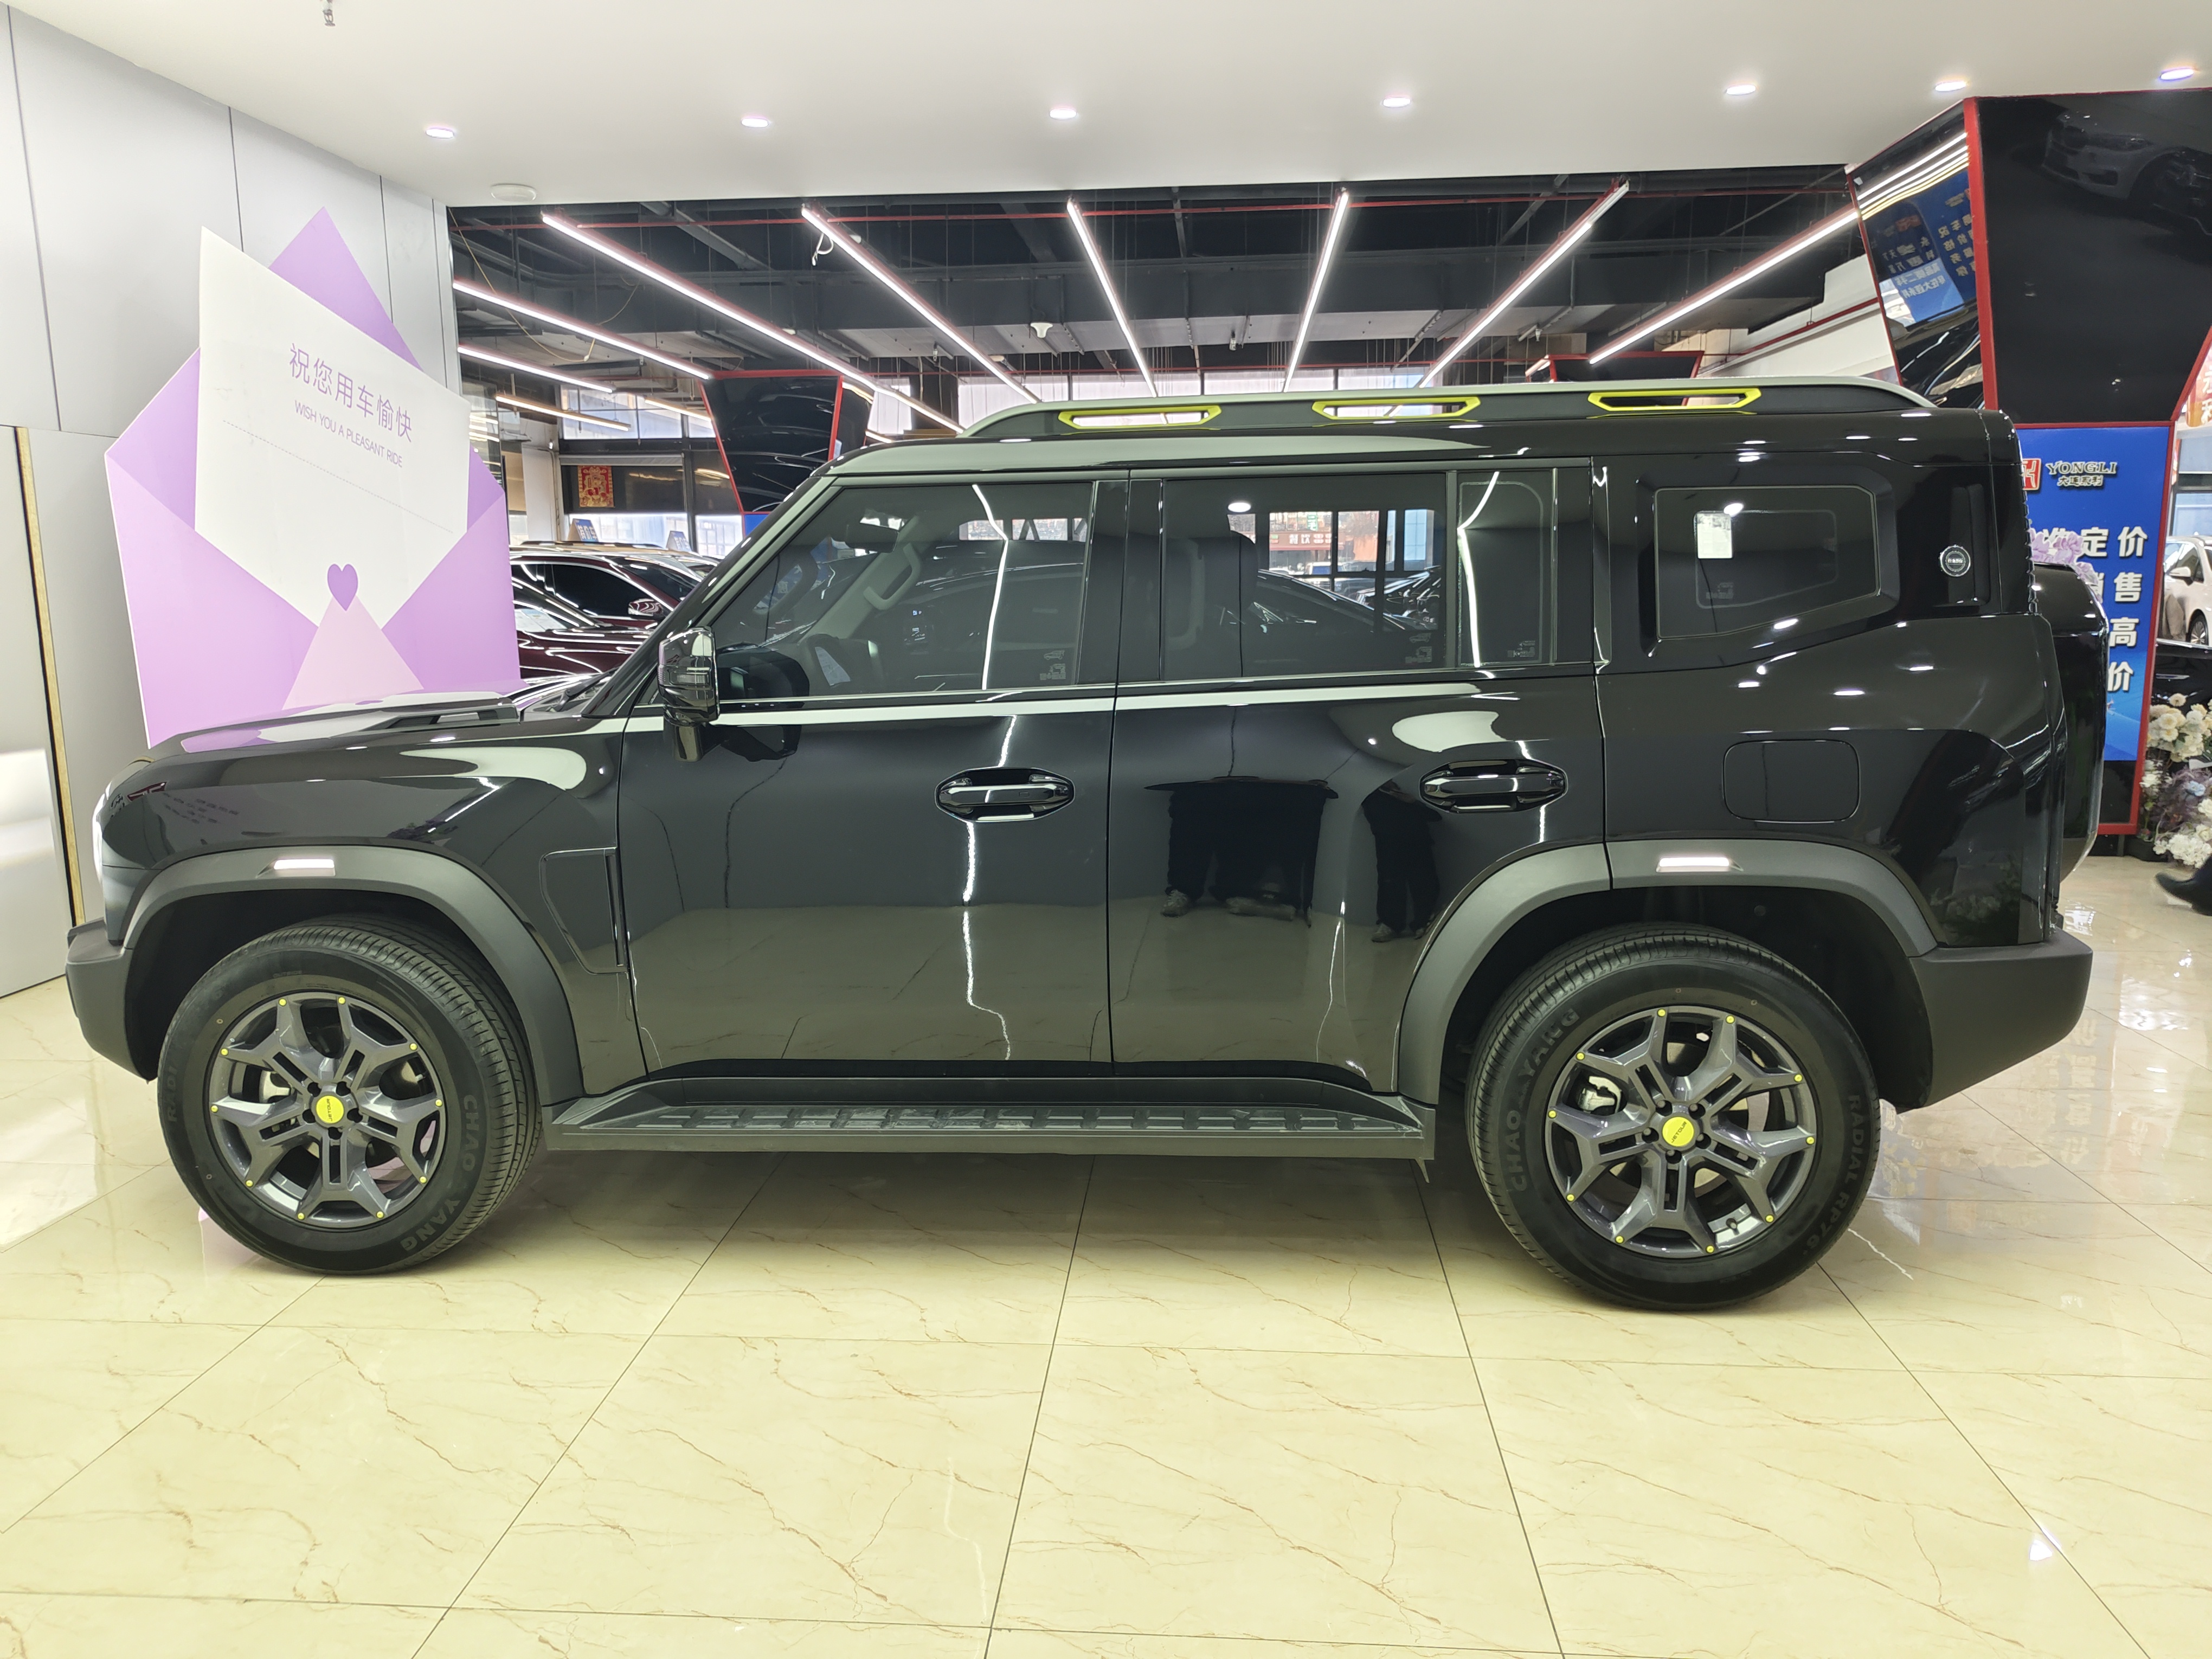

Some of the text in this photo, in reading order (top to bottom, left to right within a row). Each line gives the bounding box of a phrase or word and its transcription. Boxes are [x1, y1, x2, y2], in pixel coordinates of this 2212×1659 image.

[290, 343, 411, 442] 祝您用车愉快
[294, 400, 402, 468] WISH YOU A PLEASANT RIDE
[2046, 461, 2118, 475] YONGLI
[1507, 1008, 1580, 1192] CHAO YANG
[1671, 1121, 1687, 1143] JETOUR
[1845, 1095, 1864, 1184] RADIAL
[400, 1095, 479, 1251] CHAO YANG
